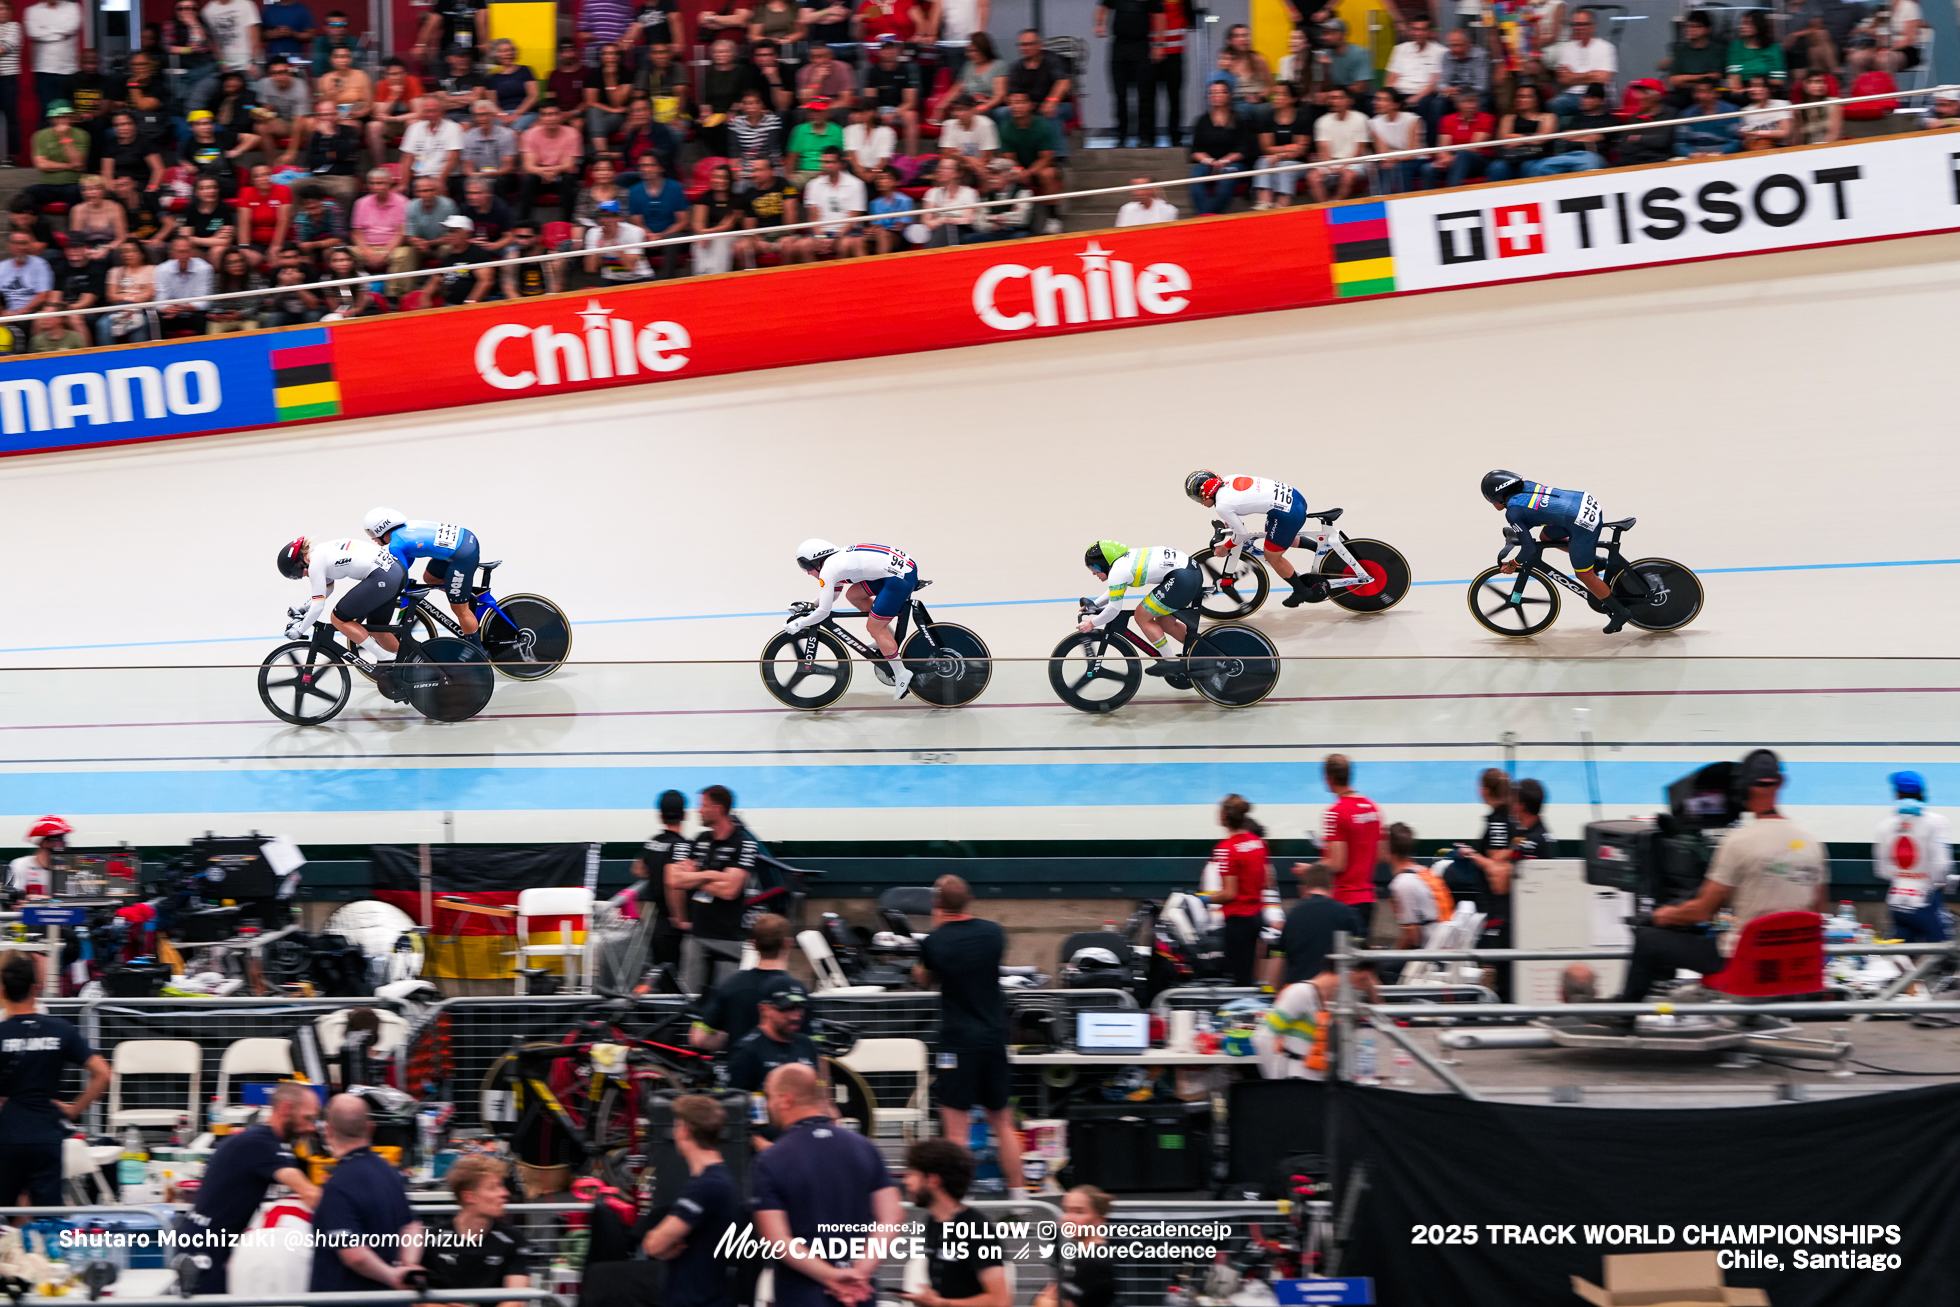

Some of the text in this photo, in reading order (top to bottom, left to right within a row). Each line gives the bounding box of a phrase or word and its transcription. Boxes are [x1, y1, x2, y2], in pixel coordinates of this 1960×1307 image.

[1558, 165, 1863, 249] TISSOT
[972, 241, 1192, 331] Chile
[474, 299, 691, 390] Chile
[0, 359, 223, 434] MANO
[1273, 488, 1292, 505] 116
[374, 519, 392, 535] KASK
[1270, 518, 1279, 540] JAPAN
[812, 547, 835, 559] LAZER
[890, 554, 905, 570] 94
[1163, 548, 1177, 561] 61
[1547, 570, 1589, 600] KOGA
[419, 599, 465, 637] PINARELLO
[804, 636, 817, 666] LOTUS
[832, 626, 868, 653] hope
[1123, 631, 1158, 657] ARGON
